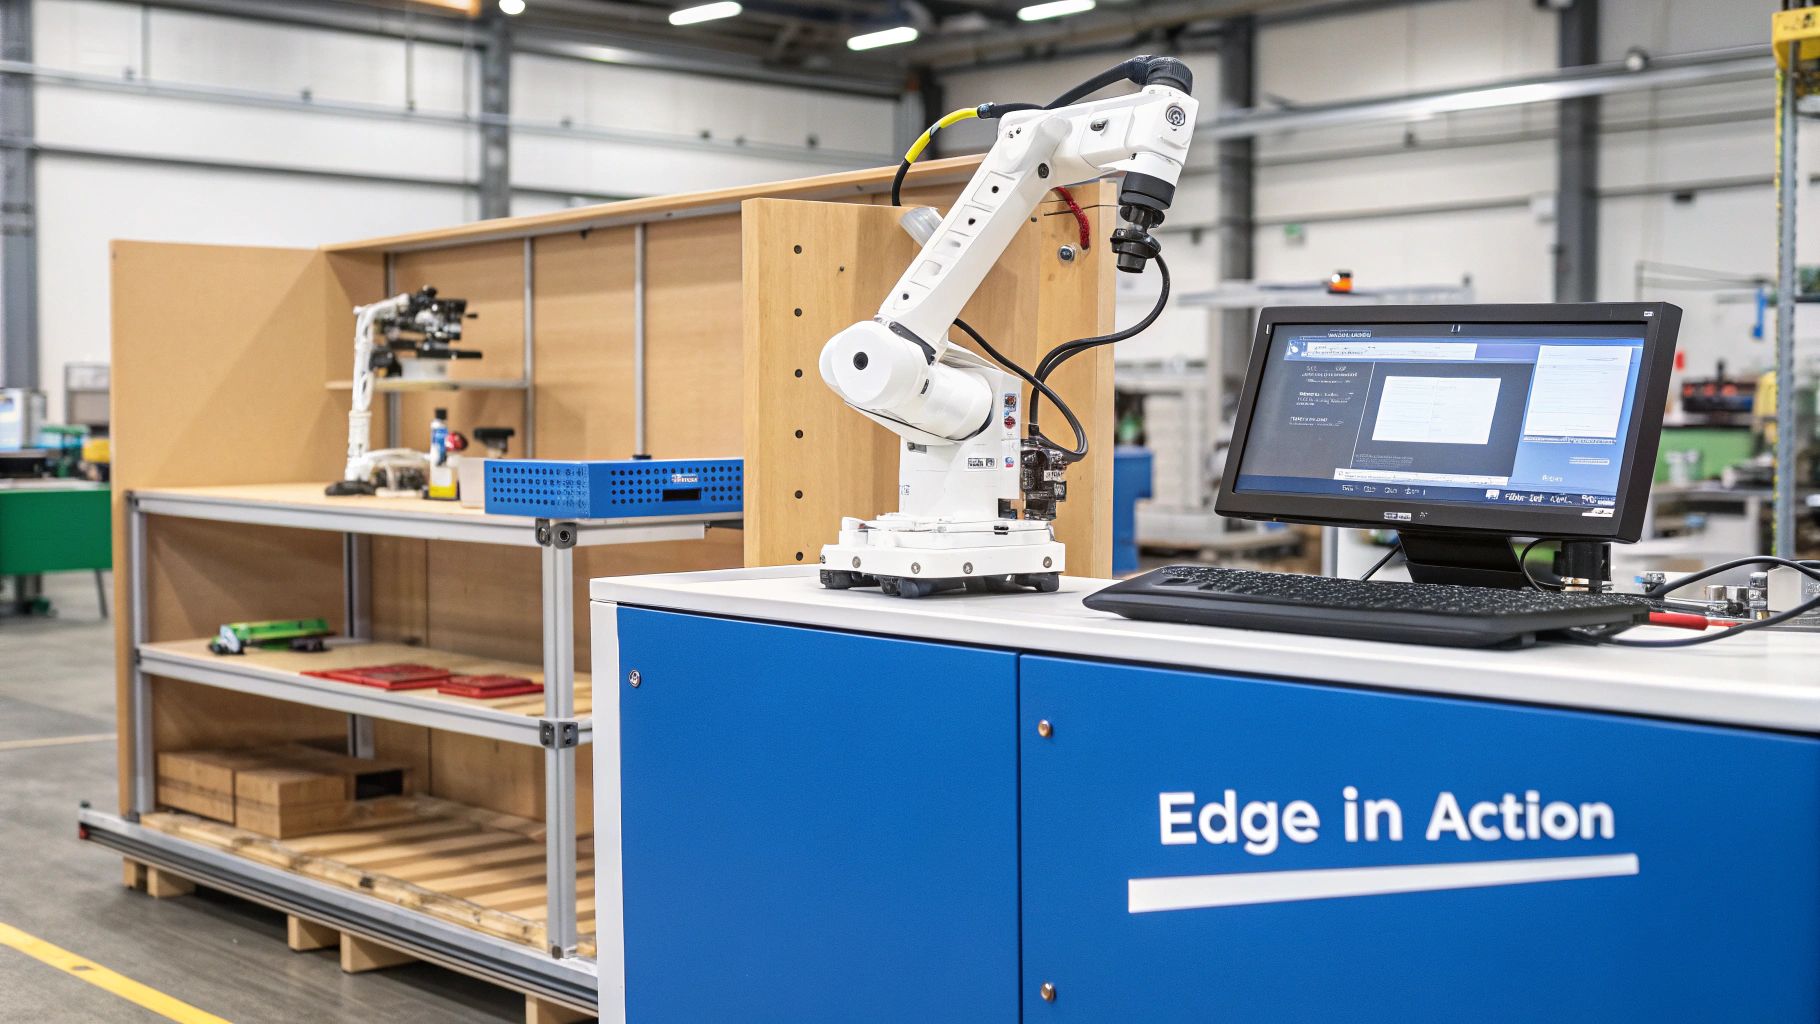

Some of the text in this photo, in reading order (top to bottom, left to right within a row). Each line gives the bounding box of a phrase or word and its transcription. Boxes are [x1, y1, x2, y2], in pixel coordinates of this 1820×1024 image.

[1159, 786, 1615, 855] Edge in Action
